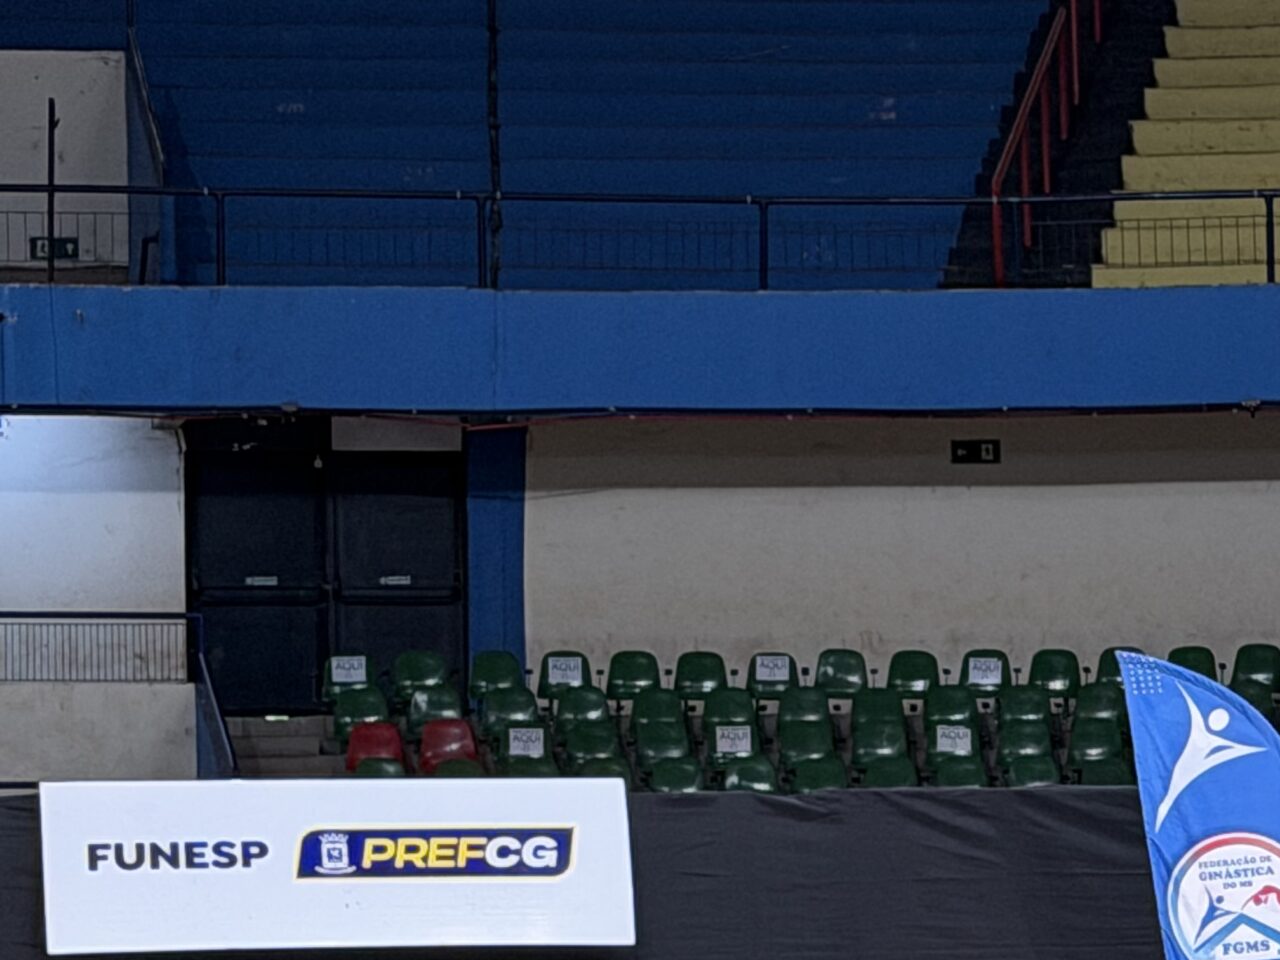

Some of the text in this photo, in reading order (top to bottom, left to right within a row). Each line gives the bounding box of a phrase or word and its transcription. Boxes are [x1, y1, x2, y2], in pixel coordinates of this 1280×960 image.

[87, 836, 558, 872] FUNESP PREFCG
[1198, 855, 1272, 869] FEDERAÇÃO DE
[1199, 865, 1275, 882] GINÁSTICA
[1222, 940, 1270, 956] FGMS
